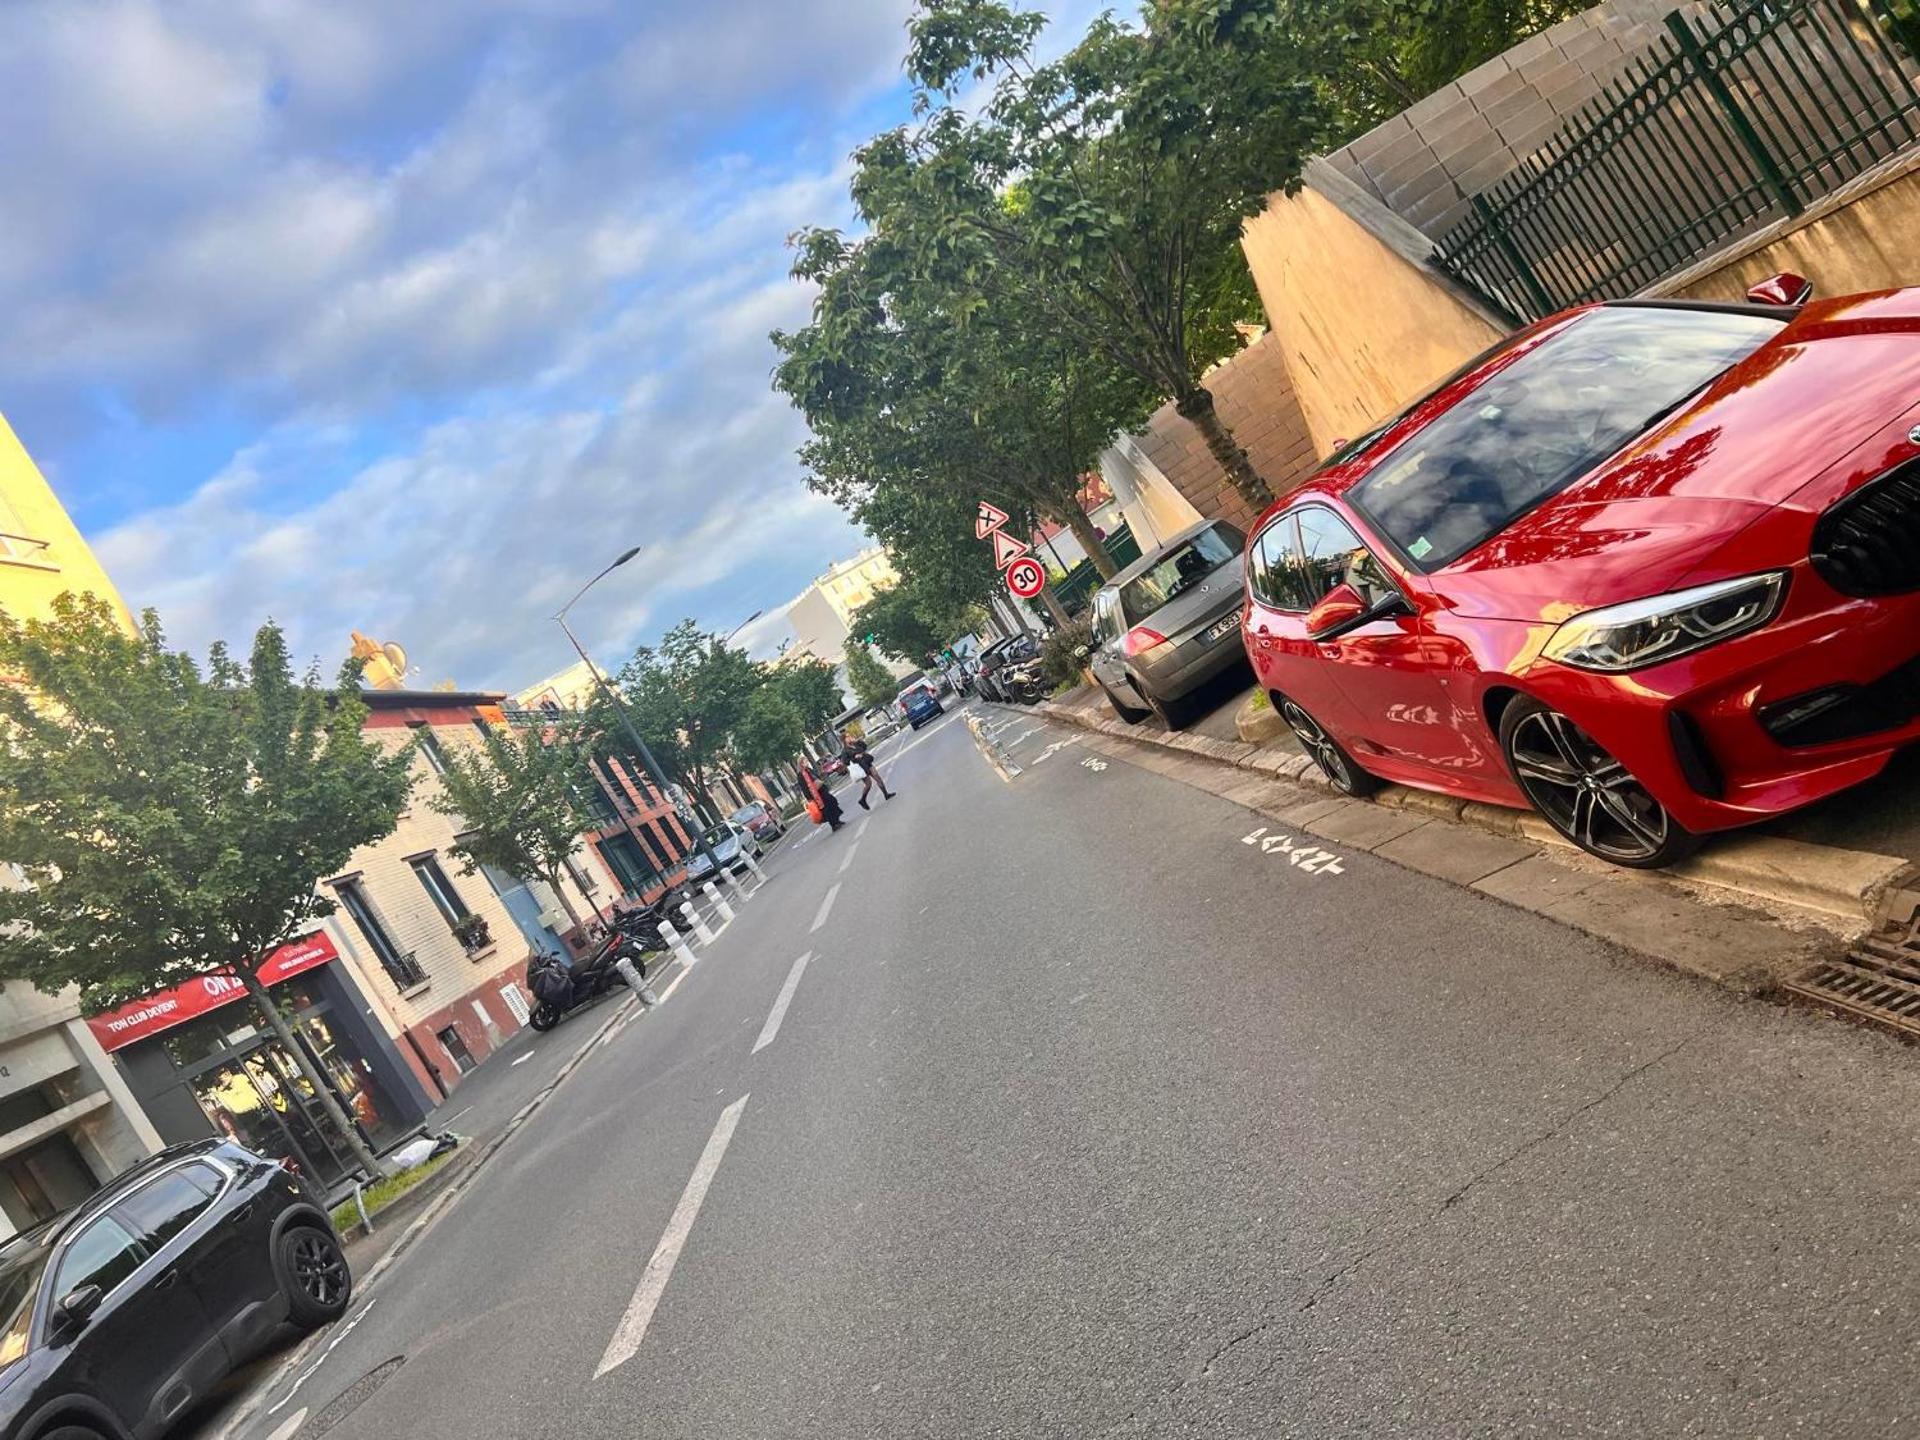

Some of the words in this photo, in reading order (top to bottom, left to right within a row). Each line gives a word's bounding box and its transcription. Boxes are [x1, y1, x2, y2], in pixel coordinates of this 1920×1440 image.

[1014, 567, 1037, 589] 30
[203, 976, 231, 996] ON
[107, 1018, 129, 1032] TON
[127, 1010, 149, 1026] CLUB
[146, 999, 178, 1018] DEVIENT
